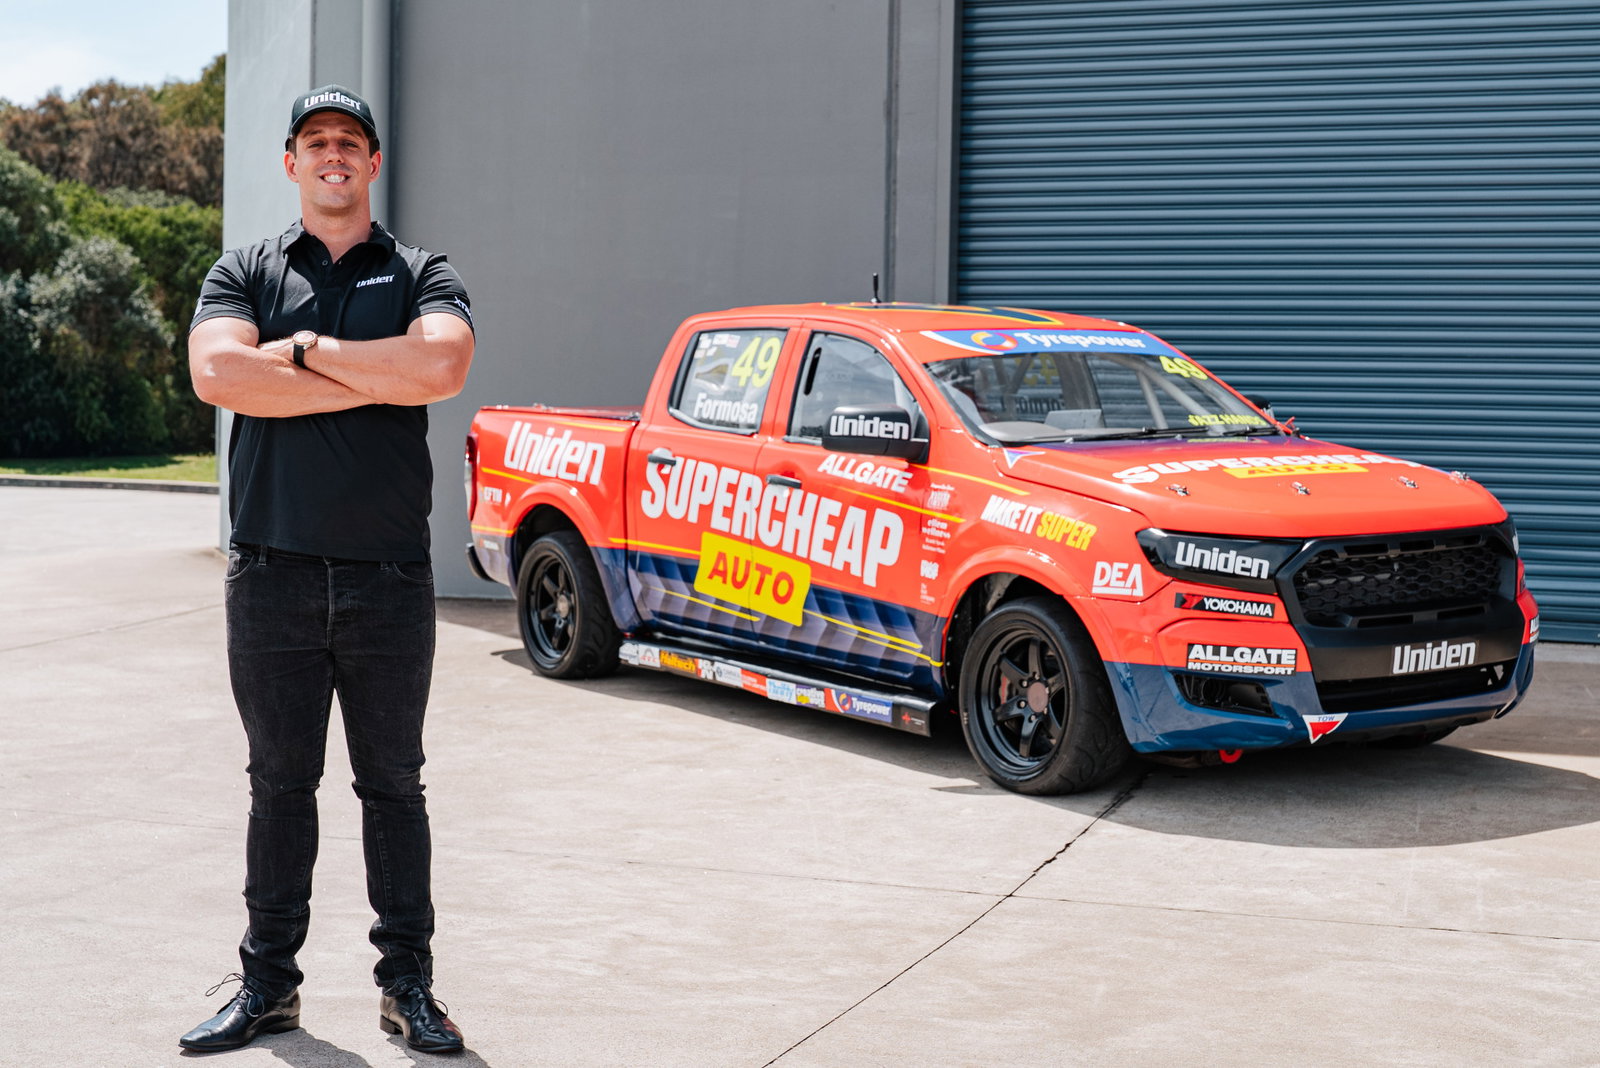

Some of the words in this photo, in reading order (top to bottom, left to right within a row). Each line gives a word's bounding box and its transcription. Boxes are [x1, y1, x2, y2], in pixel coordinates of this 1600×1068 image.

[304, 91, 361, 110] Uniden
[356, 274, 395, 288] Uniden
[1013, 332, 1146, 348] Tyrepower
[731, 336, 781, 388] 49
[1159, 355, 1208, 380] 49
[693, 392, 759, 424] Formosa
[829, 415, 910, 440] Uniden
[503, 420, 606, 486] Uniden
[817, 453, 914, 493] ALLGATE
[1248, 464, 1350, 475] AUTO
[641, 446, 904, 588] SUPERCHEAP
[980, 494, 1028, 530] MAKE
[1018, 505, 1045, 535] IT
[1036, 511, 1098, 552] SUPER
[1174, 541, 1270, 580] Uniden
[707, 551, 795, 605] AUTO
[1092, 561, 1144, 597] DEA
[1203, 597, 1273, 617] YOKOHAMA
[1188, 644, 1297, 665] ALLGATE
[1392, 640, 1477, 675] Uniden
[1187, 662, 1295, 676] MOTORSPORT
[851, 697, 890, 716] Tyrepower
